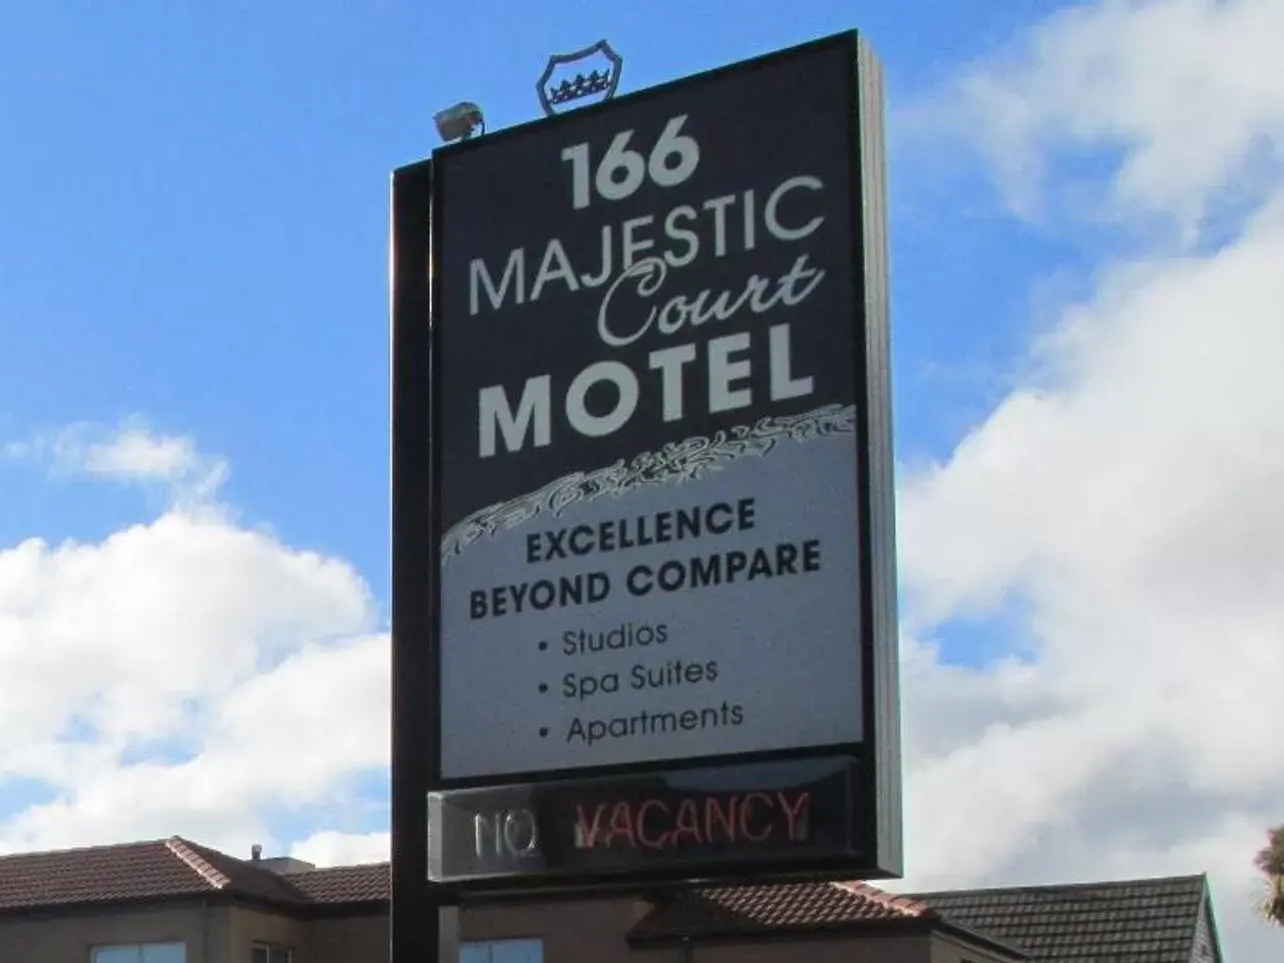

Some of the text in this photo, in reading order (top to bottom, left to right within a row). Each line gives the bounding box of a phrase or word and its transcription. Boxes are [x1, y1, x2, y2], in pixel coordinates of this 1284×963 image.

[561, 114, 700, 209] 166
[469, 176, 824, 315] MAJESTIC
[598, 254, 825, 346] Court
[478, 323, 814, 458] MOTEL
[526, 498, 756, 564] EXCELLENCE
[469, 540, 821, 619] BEYOND COMPARE
[562, 620, 668, 656] Studios
[562, 659, 717, 700] Spa Suites
[566, 701, 744, 746] Apartments
[470, 791, 810, 859] NO VACANCY
